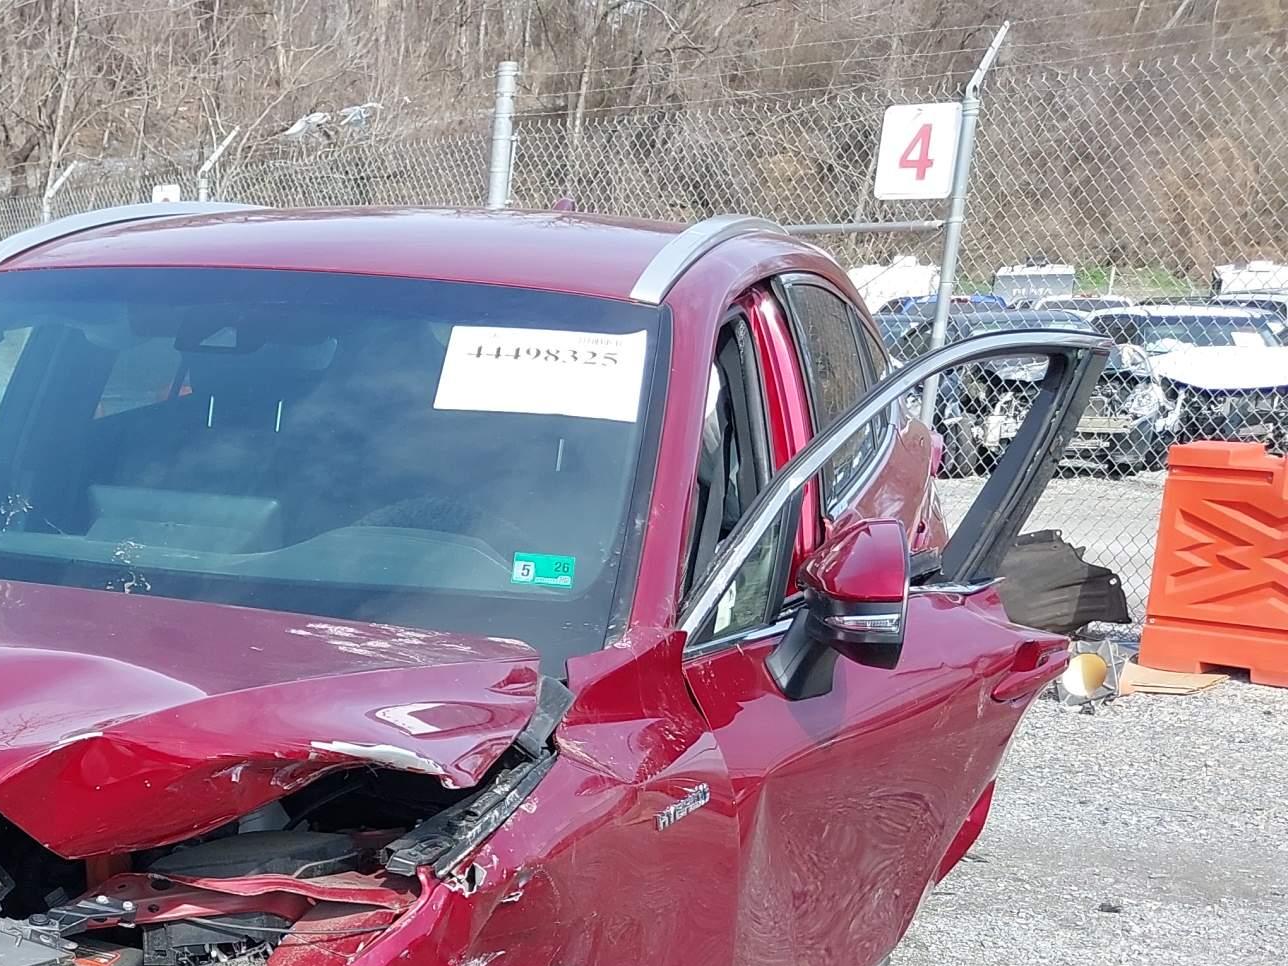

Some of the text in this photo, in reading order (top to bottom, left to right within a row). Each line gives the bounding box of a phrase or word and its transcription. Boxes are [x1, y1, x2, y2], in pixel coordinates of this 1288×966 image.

[898, 123, 935, 181] 4
[466, 344, 619, 367] 44498325
[520, 564, 532, 577] 5
[554, 561, 570, 574] 26
